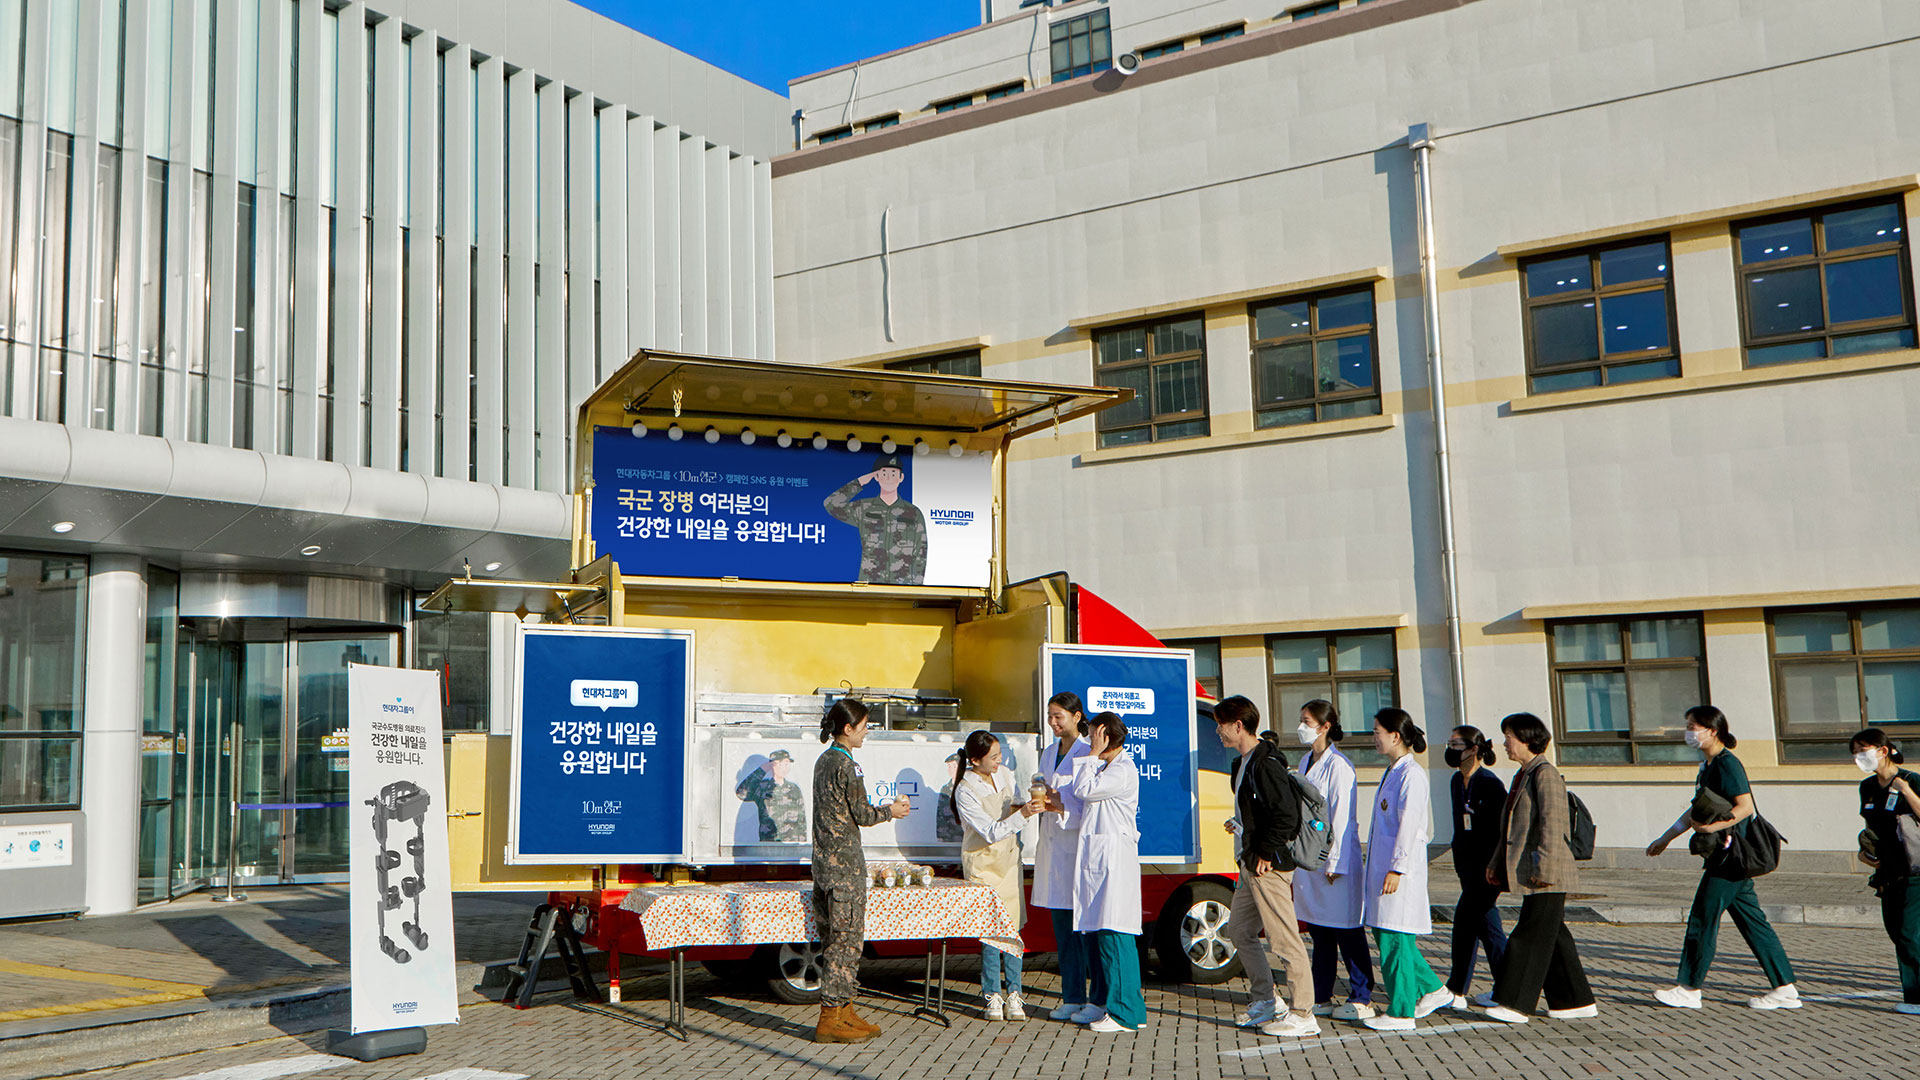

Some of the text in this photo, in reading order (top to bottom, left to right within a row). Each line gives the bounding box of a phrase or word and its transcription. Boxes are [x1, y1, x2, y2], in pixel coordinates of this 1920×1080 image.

[616, 468, 671, 480] 현대자동차그룹
[726, 474, 749, 484] 캠페인
[750, 476, 767, 485] SNS
[769, 476, 784, 487] 응원
[786, 477, 808, 488] 이벤트
[617, 489, 769, 516] 국군 장병 여러분의
[930, 509, 974, 519] HYUNDAI
[616, 516, 825, 544] 건강한 내일을 응원합니다!
[582, 687, 628, 699] 현대차그룹이
[1102, 691, 1123, 700] 혼자라서
[382, 703, 415, 714] 현대차그룹이
[1096, 700, 1108, 709] 가장
[371, 722, 404, 732] 국군수도병원
[549, 721, 658, 746] 건강한 내일을
[371, 733, 427, 750] 건강한 내일을
[376, 750, 424, 765] 응원합니다.
[559, 750, 647, 775] 응원합니다
